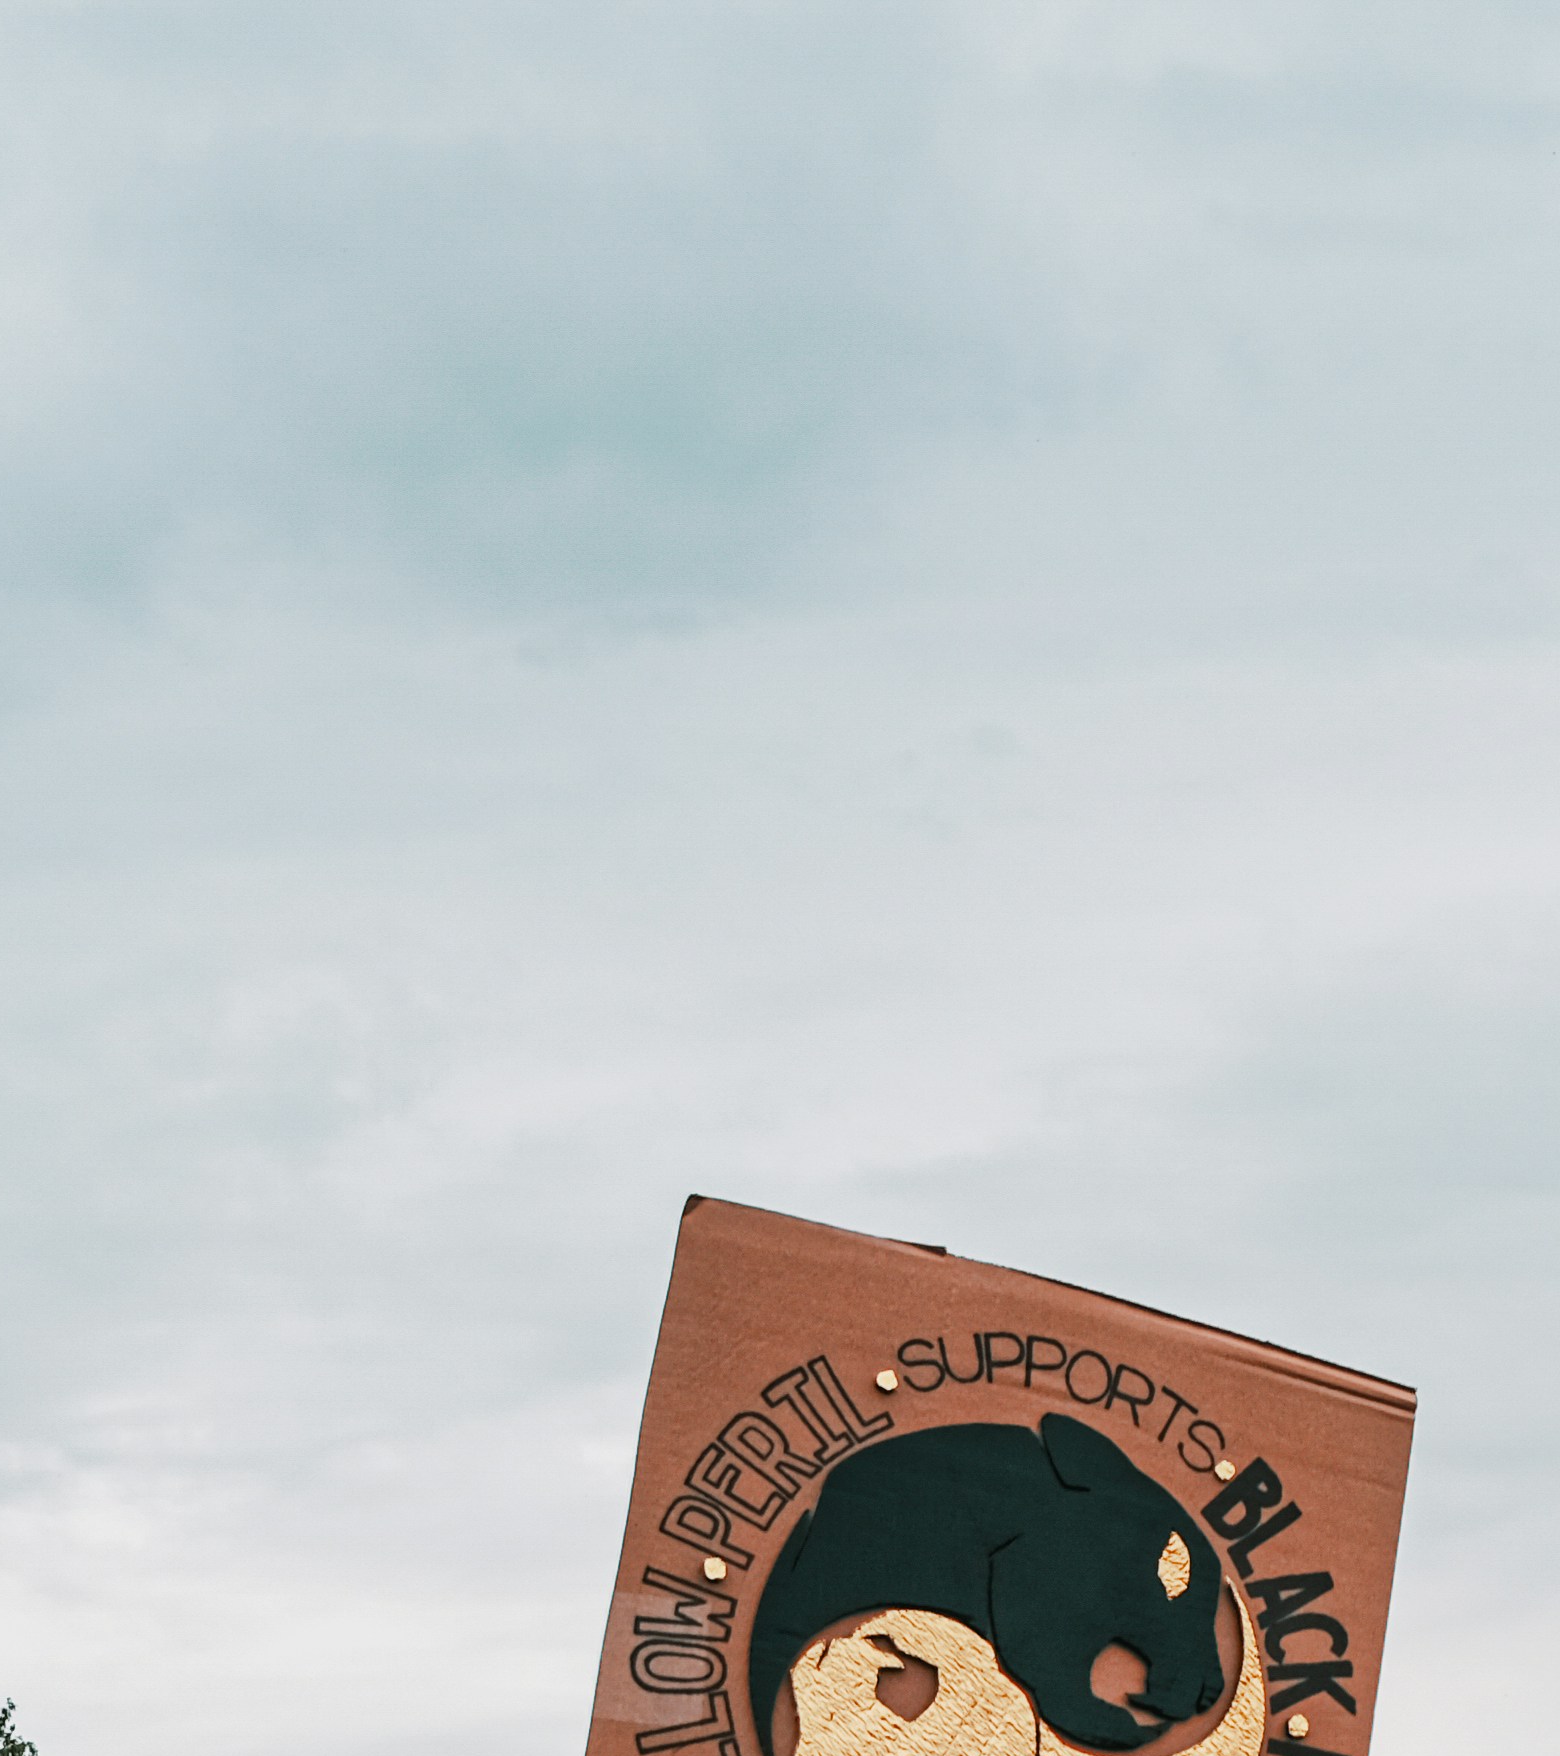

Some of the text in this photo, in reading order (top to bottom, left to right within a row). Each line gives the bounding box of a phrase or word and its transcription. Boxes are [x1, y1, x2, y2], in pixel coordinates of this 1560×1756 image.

[658, 1352, 895, 1572] PERIL
[895, 1332, 1230, 1480] SUPPORTS
[1197, 1456, 1359, 1717] BLACK
